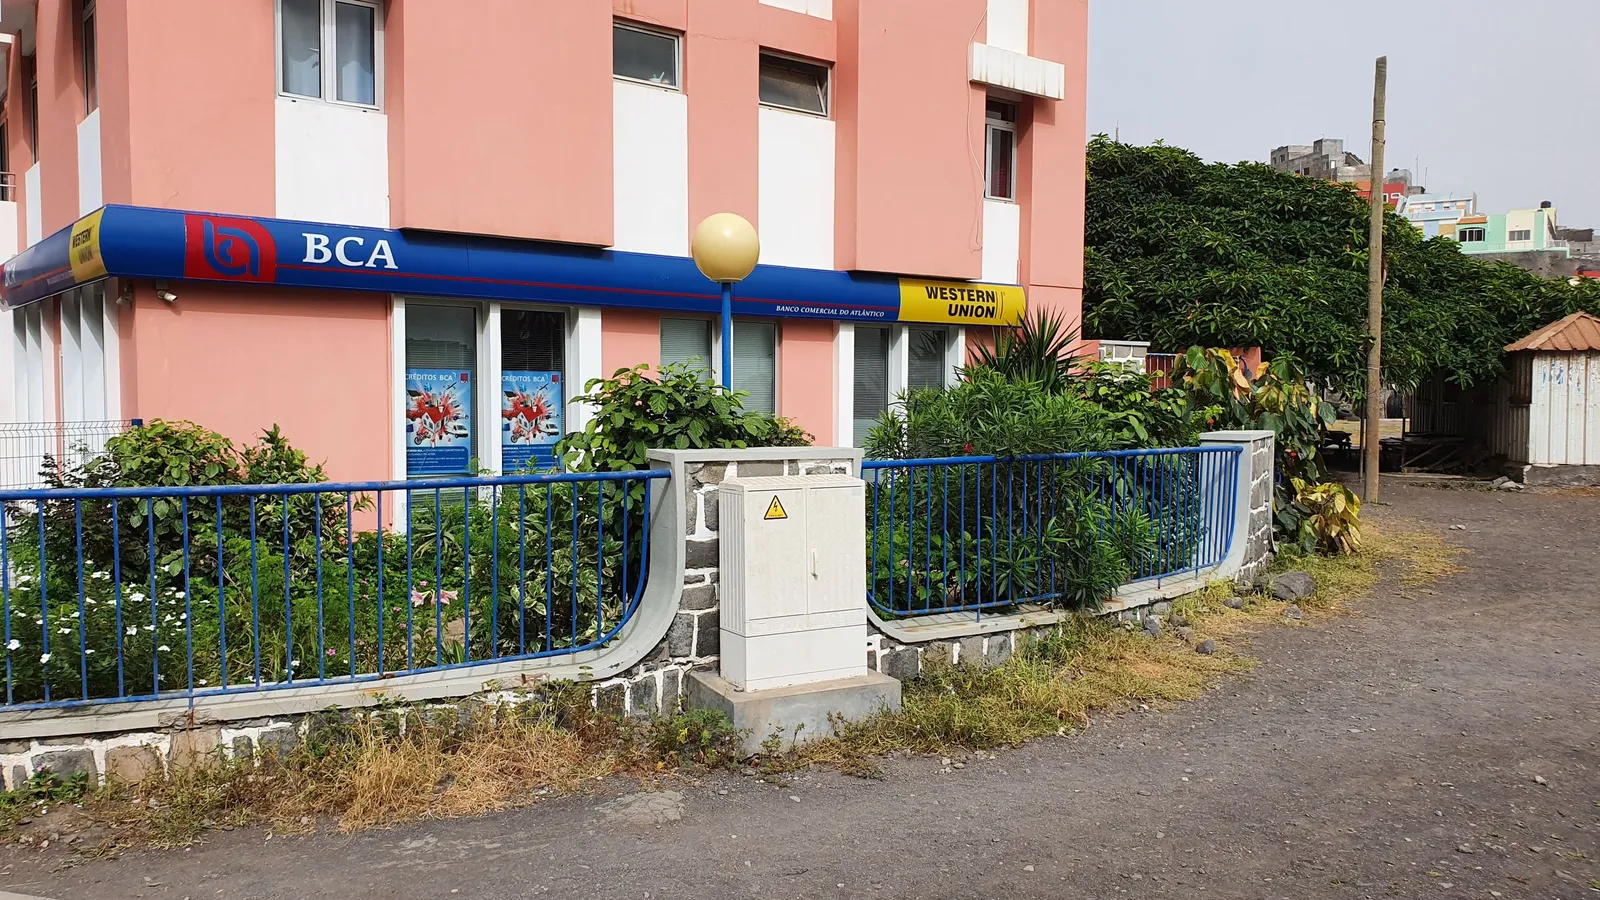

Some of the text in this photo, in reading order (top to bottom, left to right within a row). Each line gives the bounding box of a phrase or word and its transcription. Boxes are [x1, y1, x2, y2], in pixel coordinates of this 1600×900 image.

[302, 232, 398, 269] BCA
[925, 286, 995, 303] WESTERN
[776, 305, 799, 313] BANCO
[800, 307, 838, 315] COMERCIAL
[850, 309, 885, 318] ATLÂNTICO
[948, 304, 995, 318] UNION
